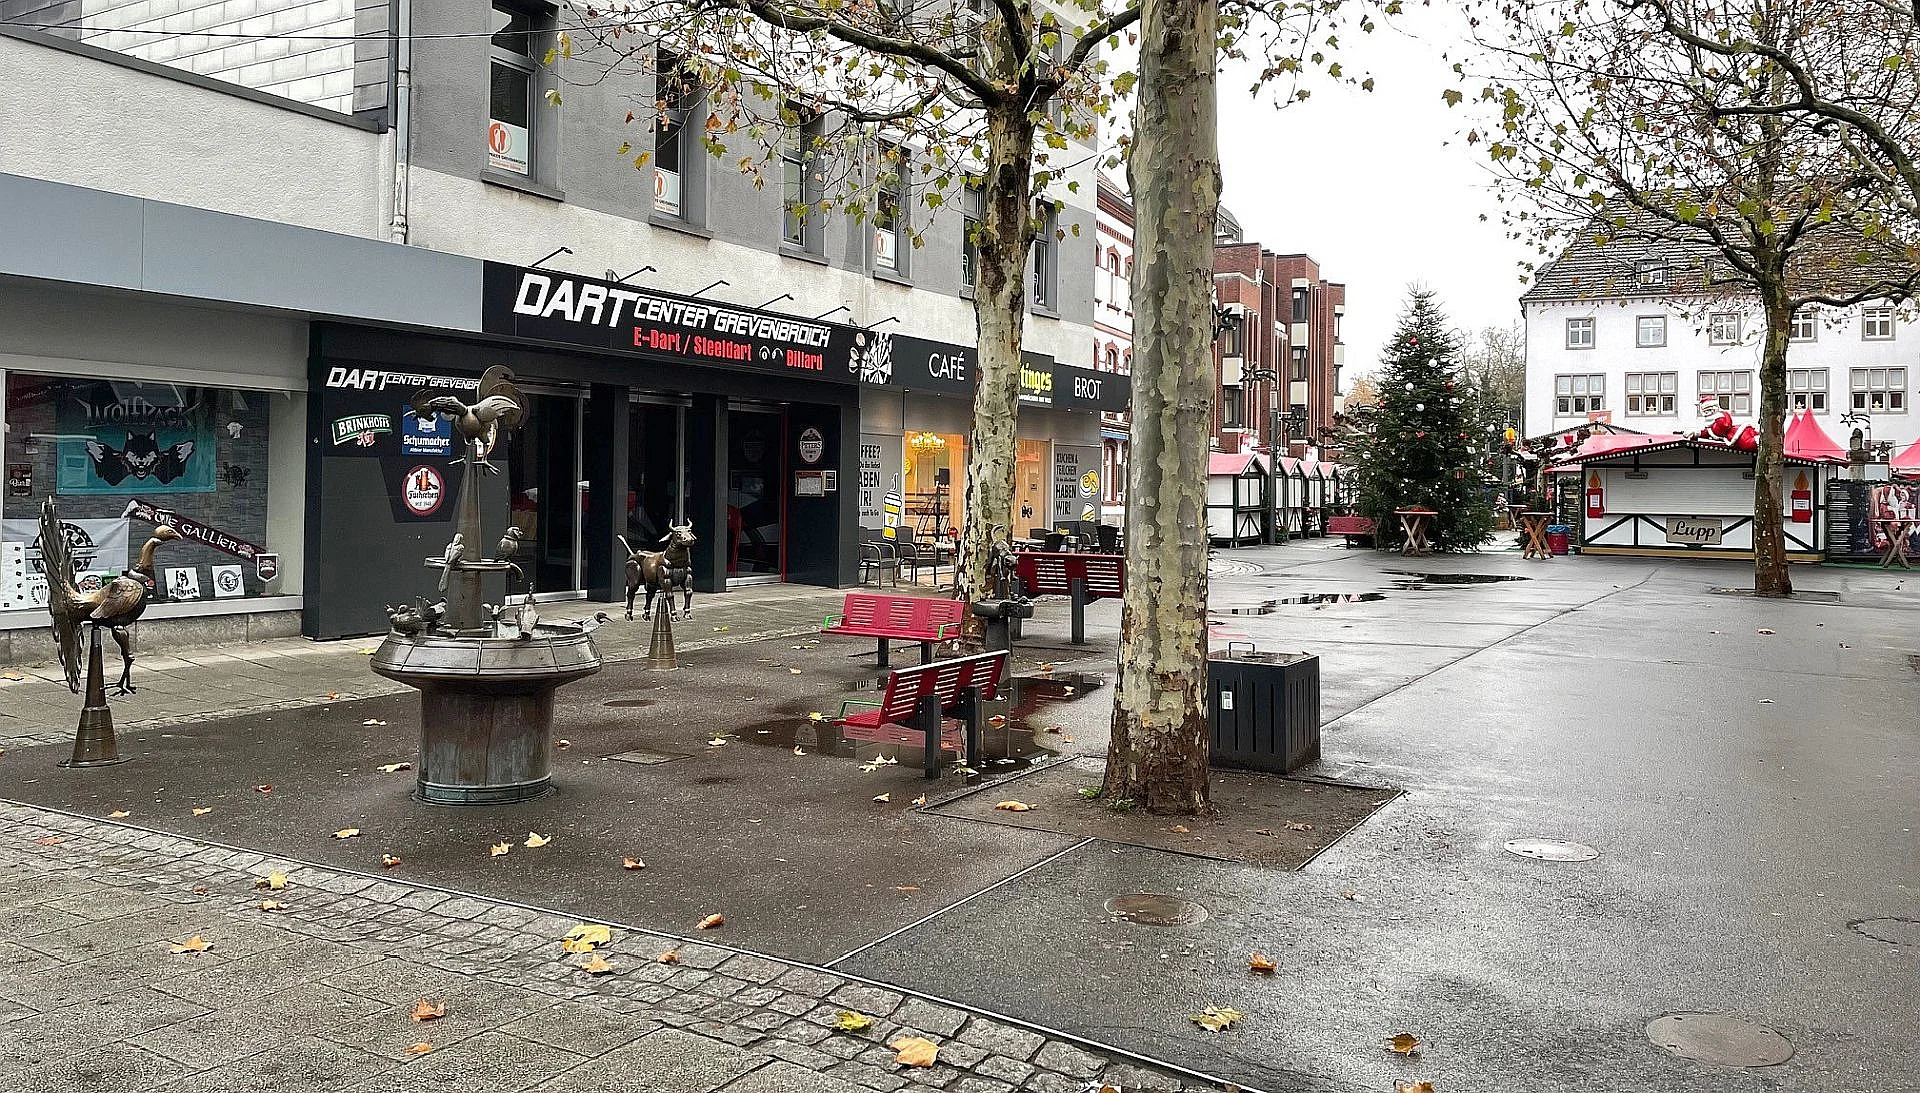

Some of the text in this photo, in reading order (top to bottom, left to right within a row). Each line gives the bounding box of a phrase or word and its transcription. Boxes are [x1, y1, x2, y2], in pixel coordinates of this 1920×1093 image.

[513, 272, 832, 348] DART CENTER GREVENBROICH
[633, 326, 681, 351] E-Dart
[693, 334, 753, 361] Steeldart
[786, 348, 824, 371] Billard
[928, 351, 966, 381] CAFÉ
[325, 366, 481, 391] DART CENTER GREVENBR
[1020, 362, 1052, 395] tinges
[1074, 376, 1102, 400] BROT
[403, 434, 450, 448] Schumacher
[860, 444, 880, 459] FFEE?
[858, 471, 880, 488] ABEN
[860, 490, 872, 507] IR!
[1055, 484, 1077, 499] HABEN
[1055, 500, 1072, 516] WIR!
[1672, 520, 1716, 542] Lupp
